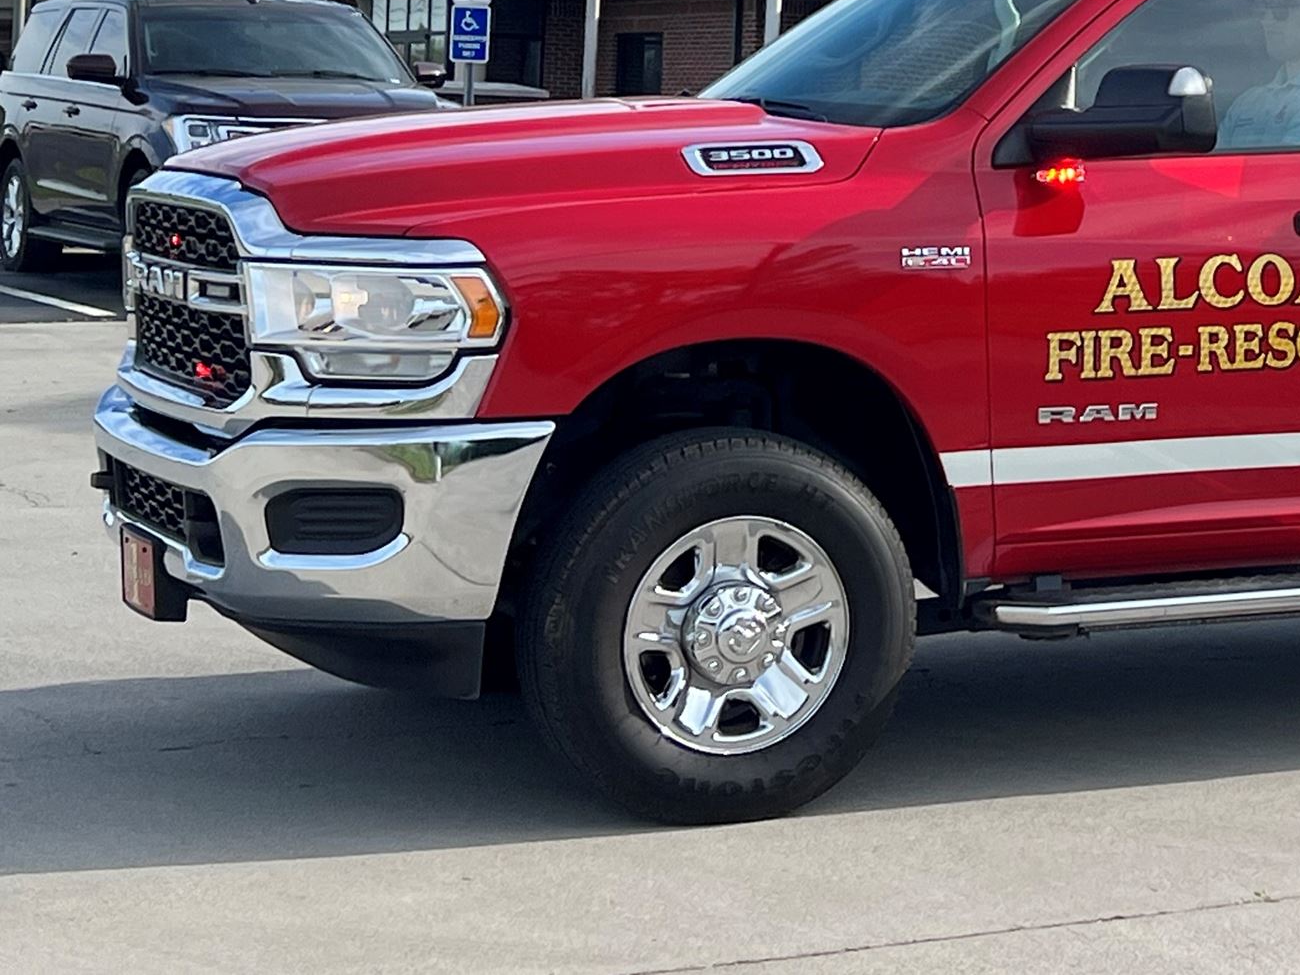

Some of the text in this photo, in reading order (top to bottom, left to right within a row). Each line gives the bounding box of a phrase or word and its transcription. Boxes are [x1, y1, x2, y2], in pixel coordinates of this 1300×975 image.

[709, 147, 794, 162] 3500
[901, 246, 970, 257] HEMI
[1038, 402, 1158, 425] RAM
